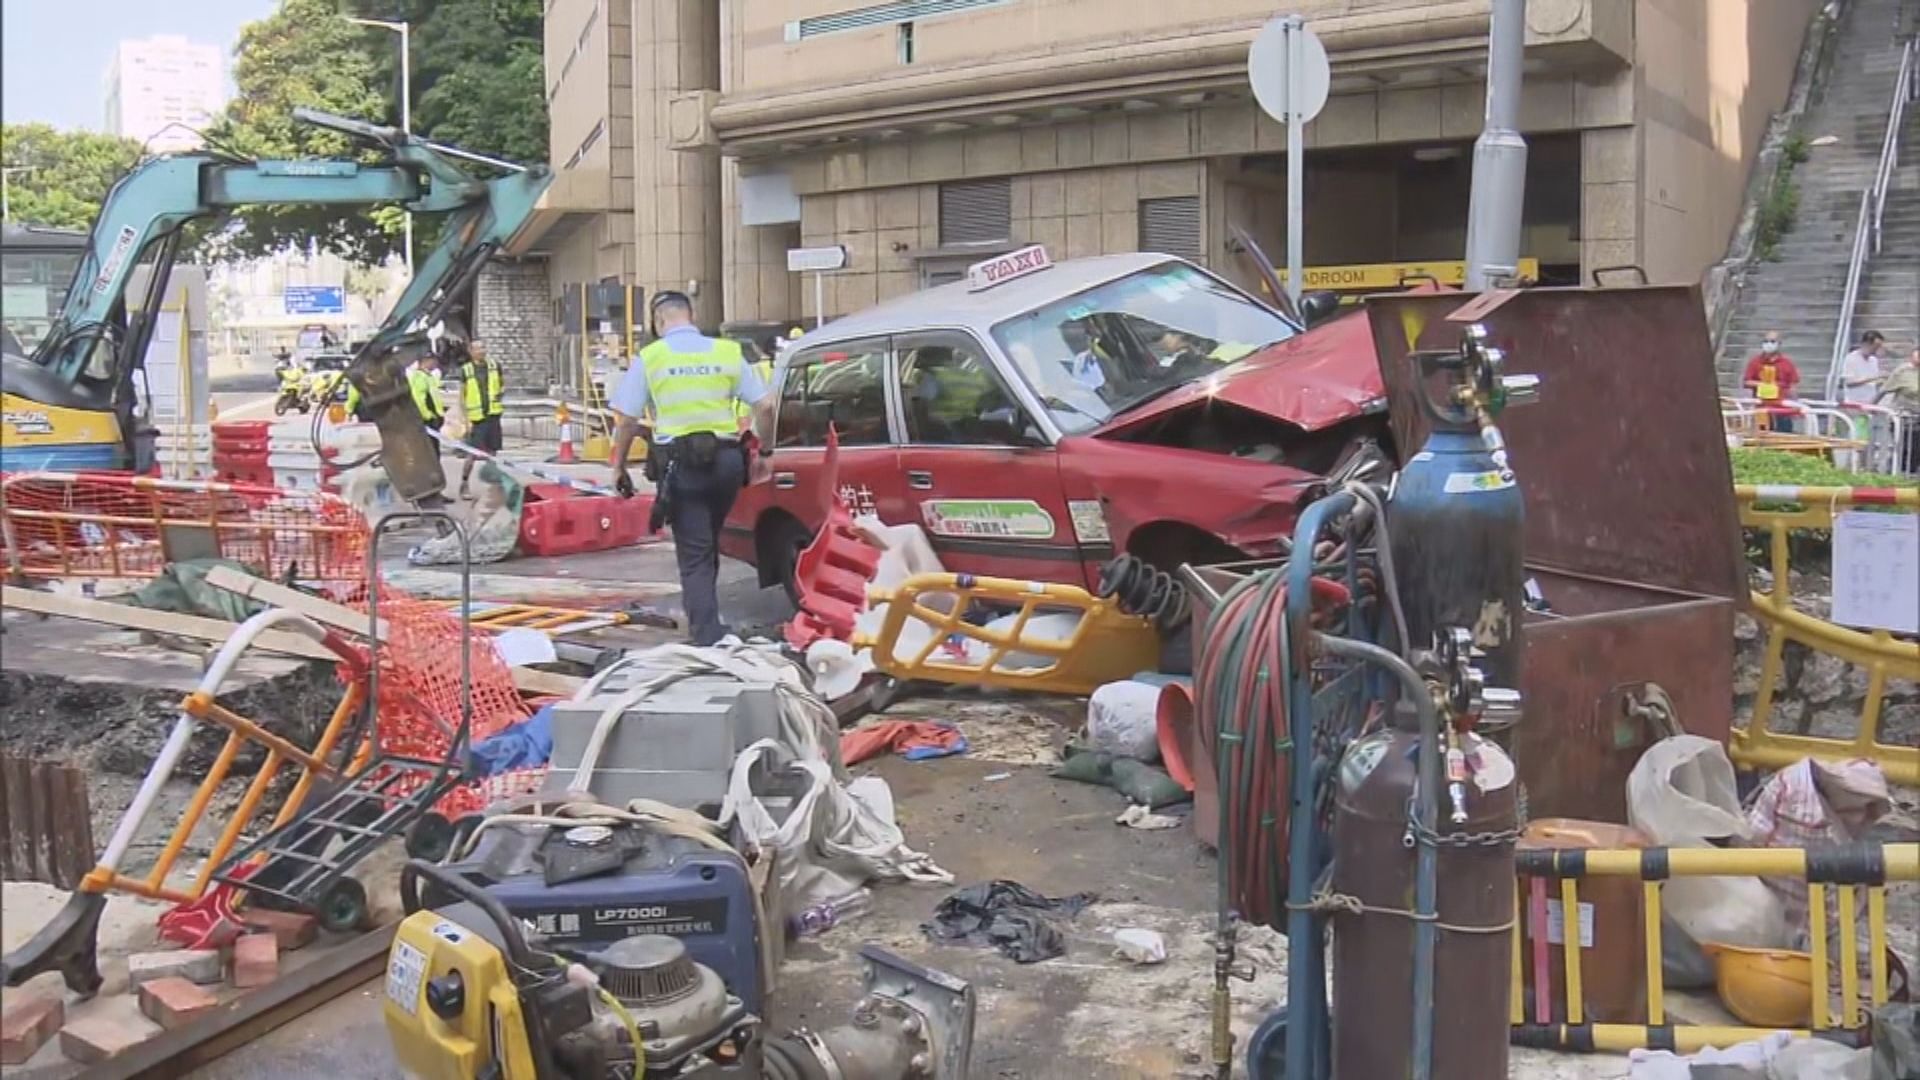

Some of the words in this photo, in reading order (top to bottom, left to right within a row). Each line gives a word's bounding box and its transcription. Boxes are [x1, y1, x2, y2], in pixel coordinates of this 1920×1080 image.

[982, 248, 1045, 281] TAXI
[1280, 271, 1365, 286] HADROOM
[679, 365, 710, 376] POLICE
